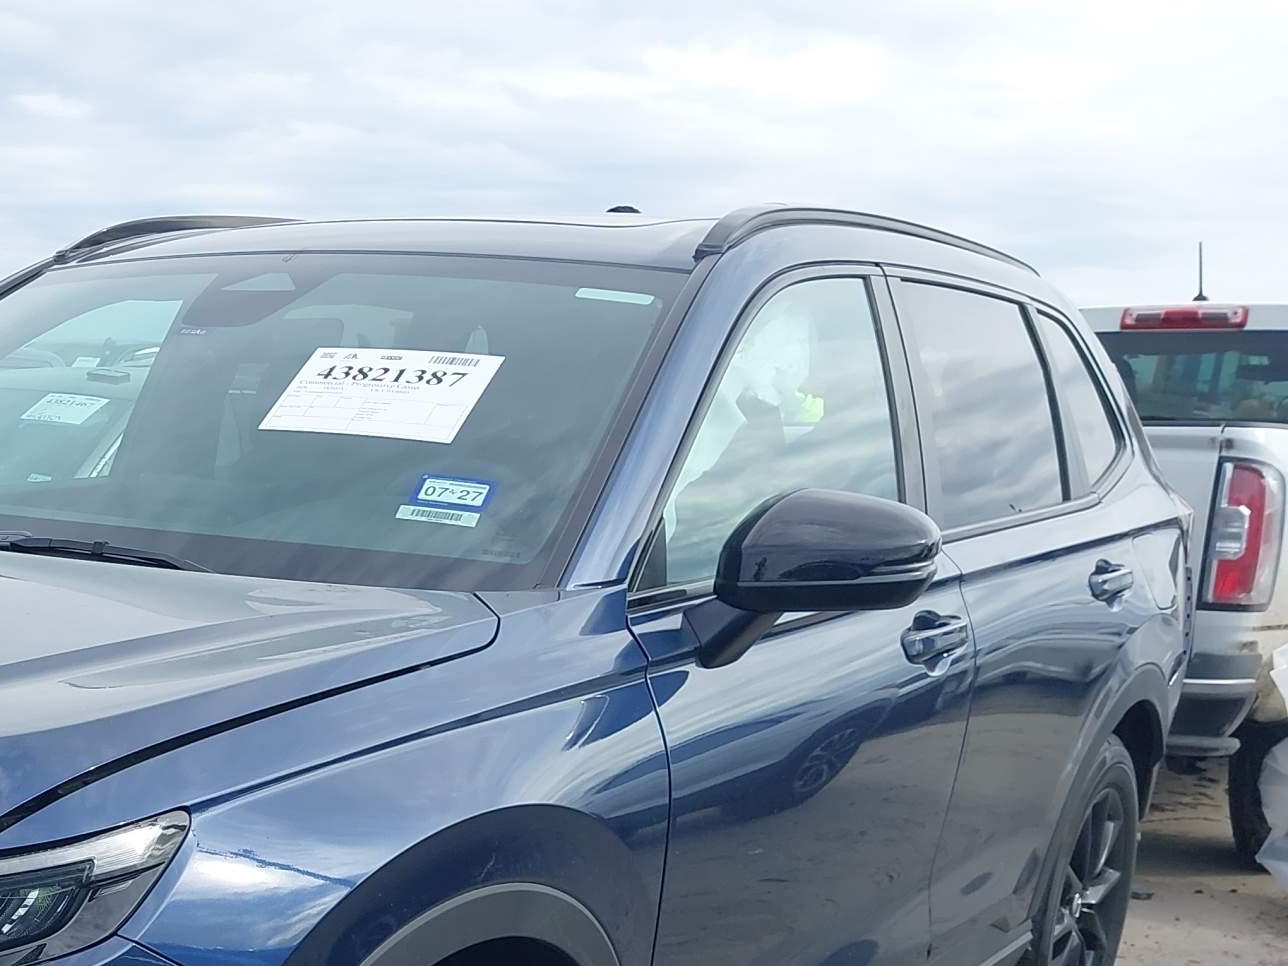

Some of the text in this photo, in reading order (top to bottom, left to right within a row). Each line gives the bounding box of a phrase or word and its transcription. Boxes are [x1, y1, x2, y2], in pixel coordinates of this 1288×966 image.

[316, 364, 469, 388] 43821387
[424, 485, 450, 498] 07
[456, 489, 484, 502] 27
